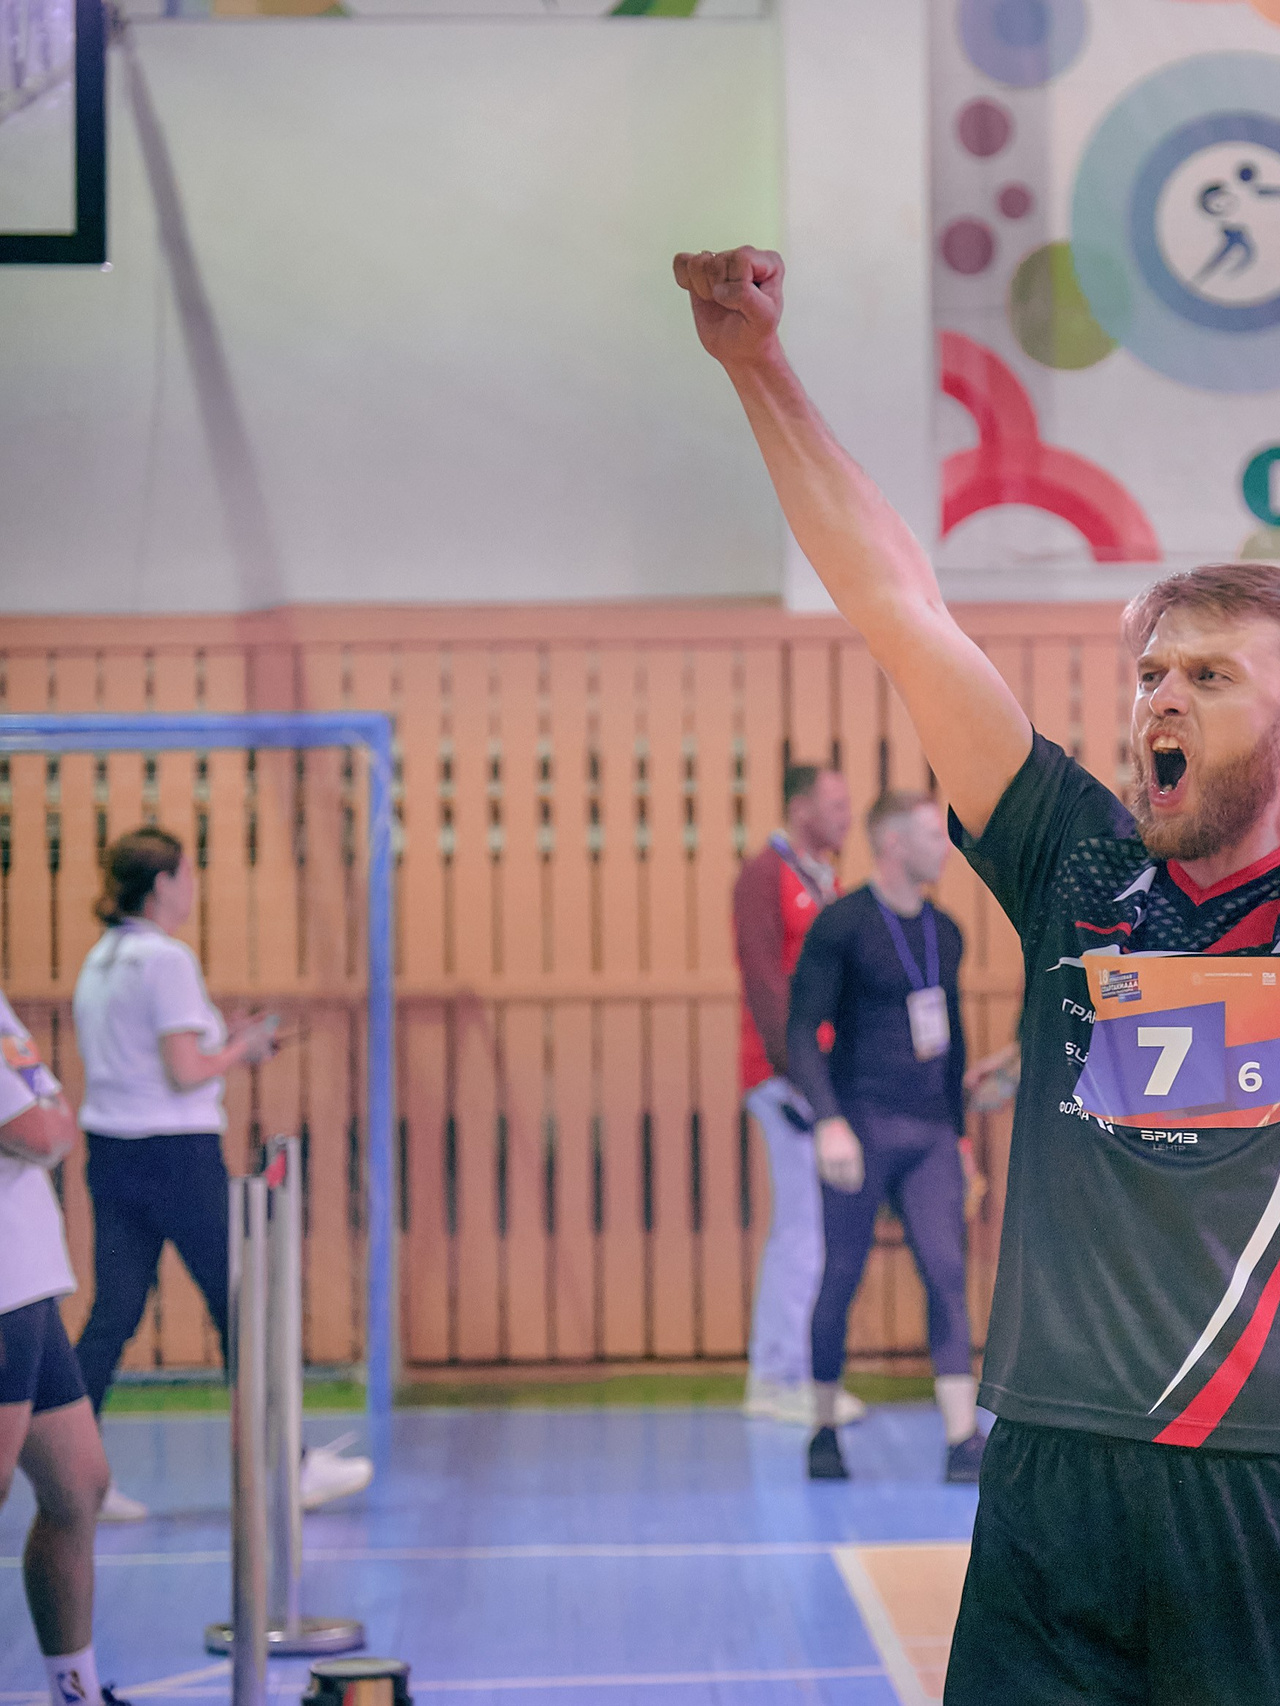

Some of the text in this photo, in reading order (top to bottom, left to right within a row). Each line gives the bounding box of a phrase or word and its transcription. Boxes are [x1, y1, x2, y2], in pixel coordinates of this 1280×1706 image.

[1137, 1026, 1193, 1096] 7
[1238, 1061, 1263, 1093] 6
[1140, 1129, 1199, 1145] БРИЗ
